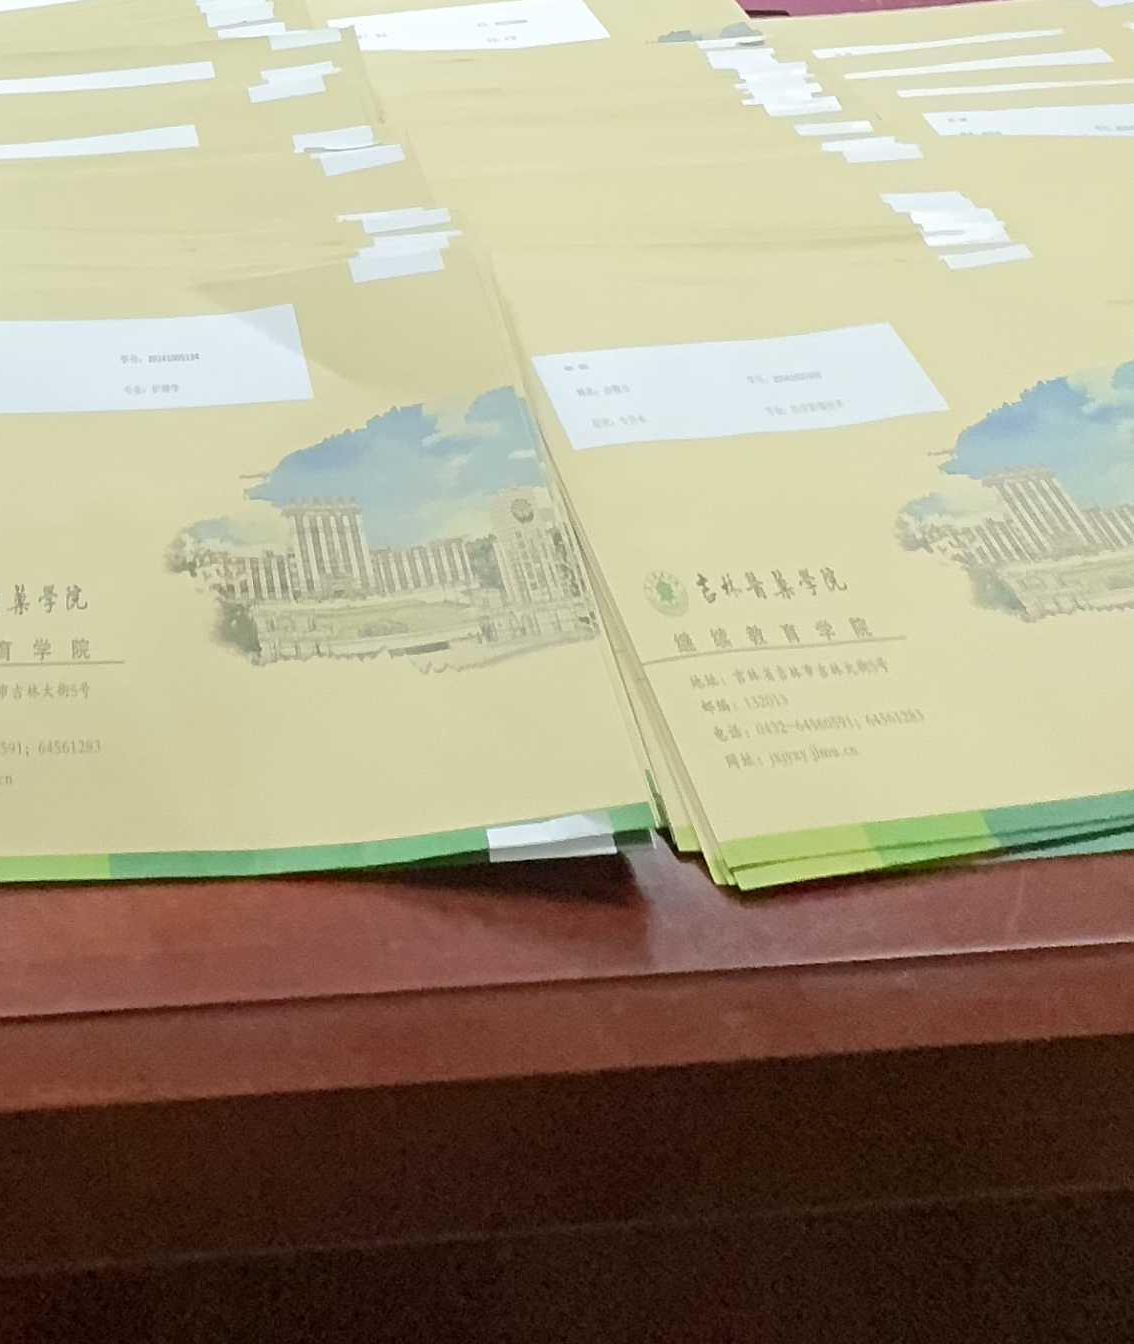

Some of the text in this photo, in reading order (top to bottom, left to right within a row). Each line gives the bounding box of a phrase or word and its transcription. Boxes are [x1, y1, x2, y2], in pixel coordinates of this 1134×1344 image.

[673, 616, 873, 653] 继续教育学院
